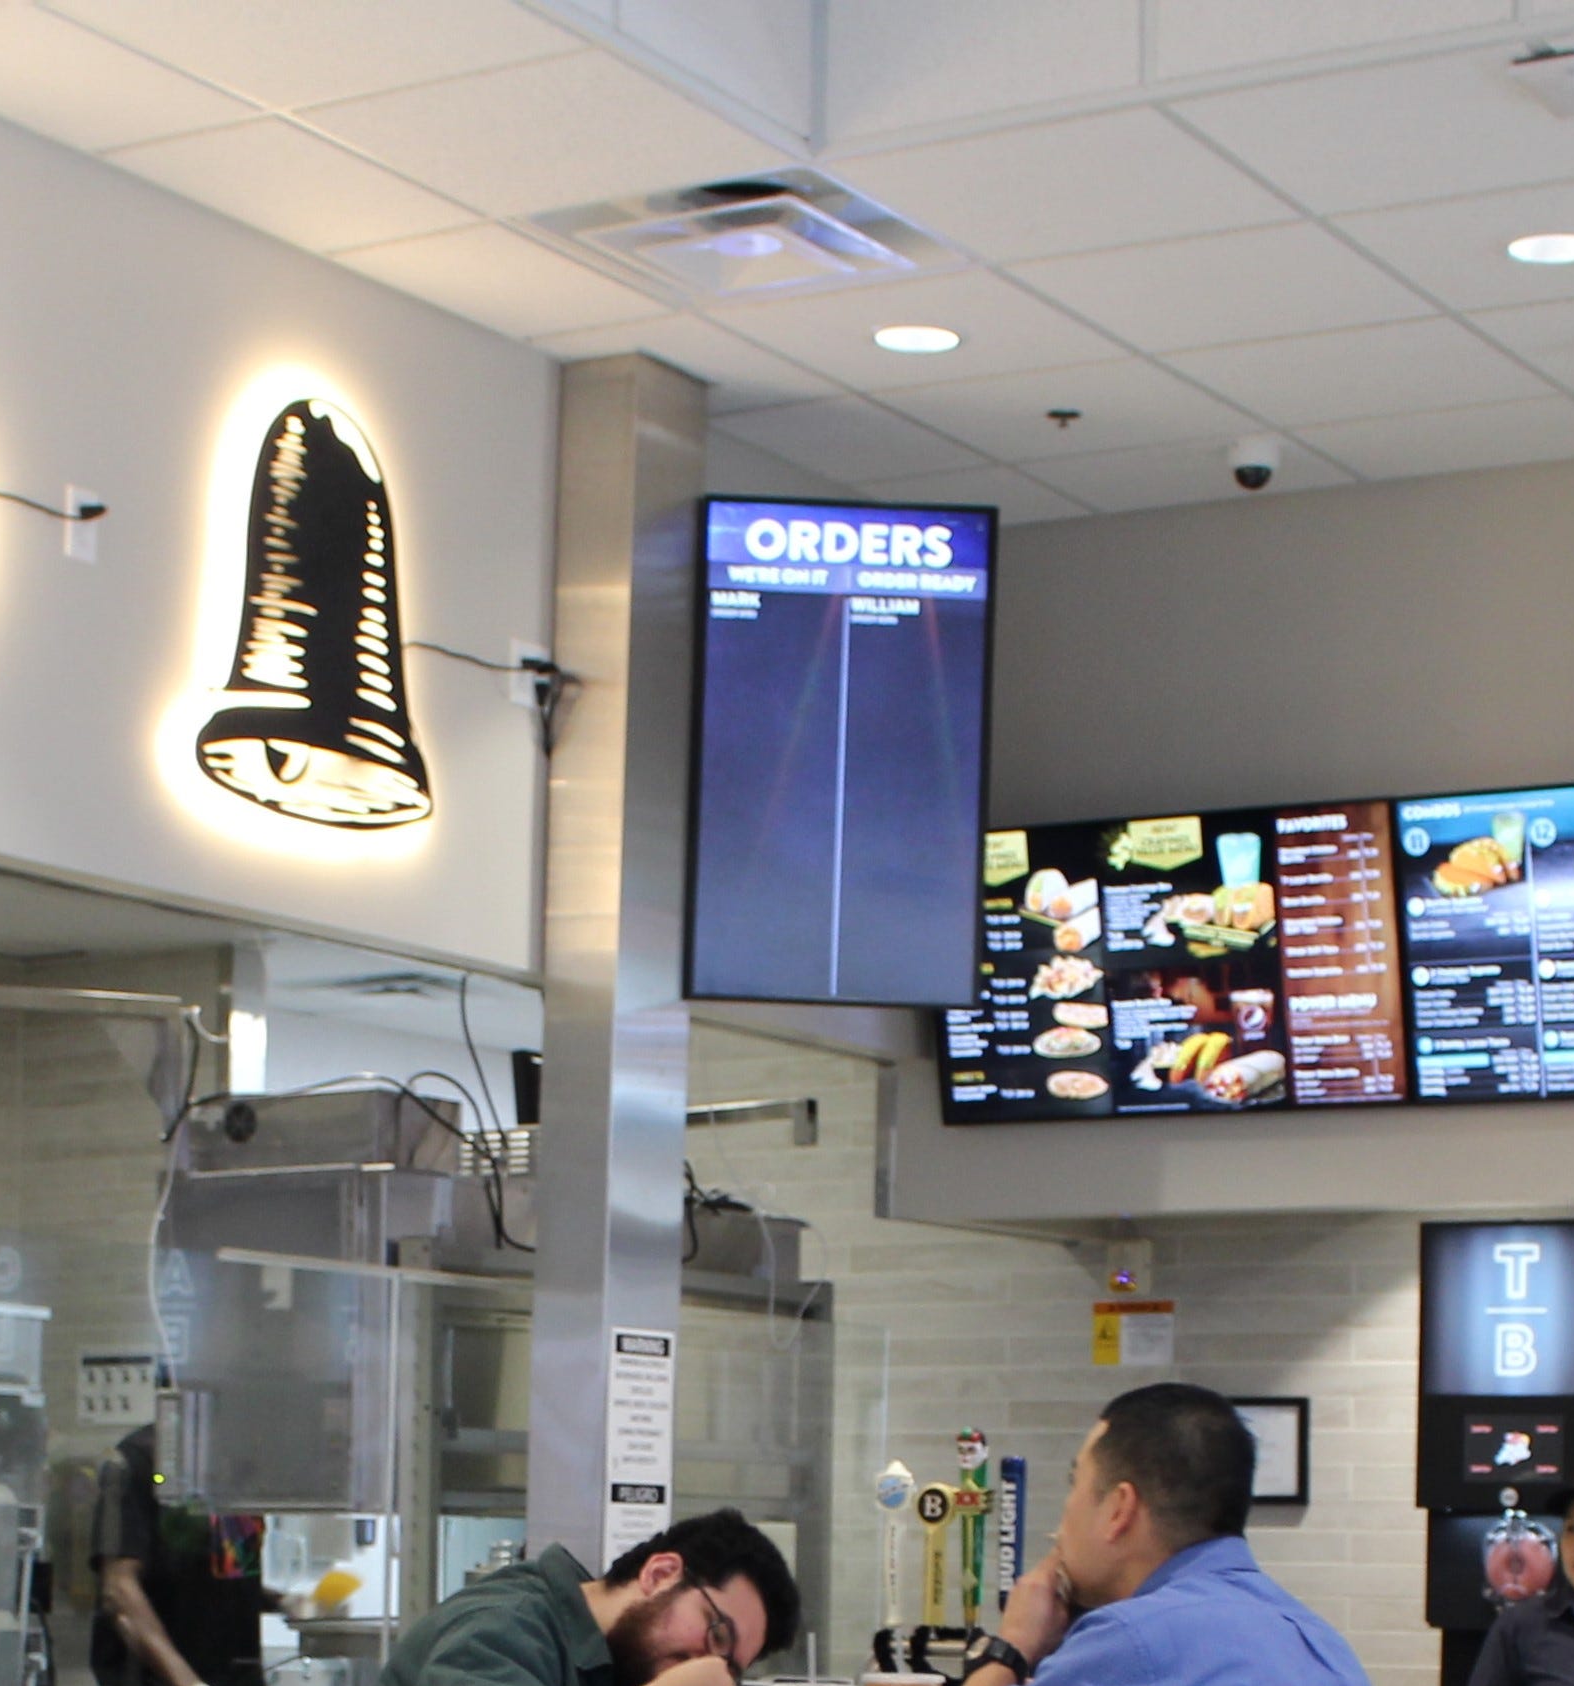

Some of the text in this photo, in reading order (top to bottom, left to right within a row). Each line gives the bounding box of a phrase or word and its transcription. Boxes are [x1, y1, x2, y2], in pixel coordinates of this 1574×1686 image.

[745, 518, 953, 568] ORDERS
[727, 565, 829, 587] WE'RE ON IT
[857, 571, 977, 593] ORDER READY
[711, 590, 761, 608] MARK
[851, 597, 920, 615] WILLIAM
[1401, 802, 1461, 822] COMBOS
[1276, 813, 1348, 834] FAVORITES
[1535, 825, 1551, 841] 12
[1410, 834, 1424, 850] 11
[1289, 993, 1377, 1013] POWER MENU
[1493, 1242, 1540, 1300] T
[1494, 1322, 1537, 1377] B
[923, 1494, 943, 1518] B
[999, 1480, 1017, 1592] BUD LIGHT
